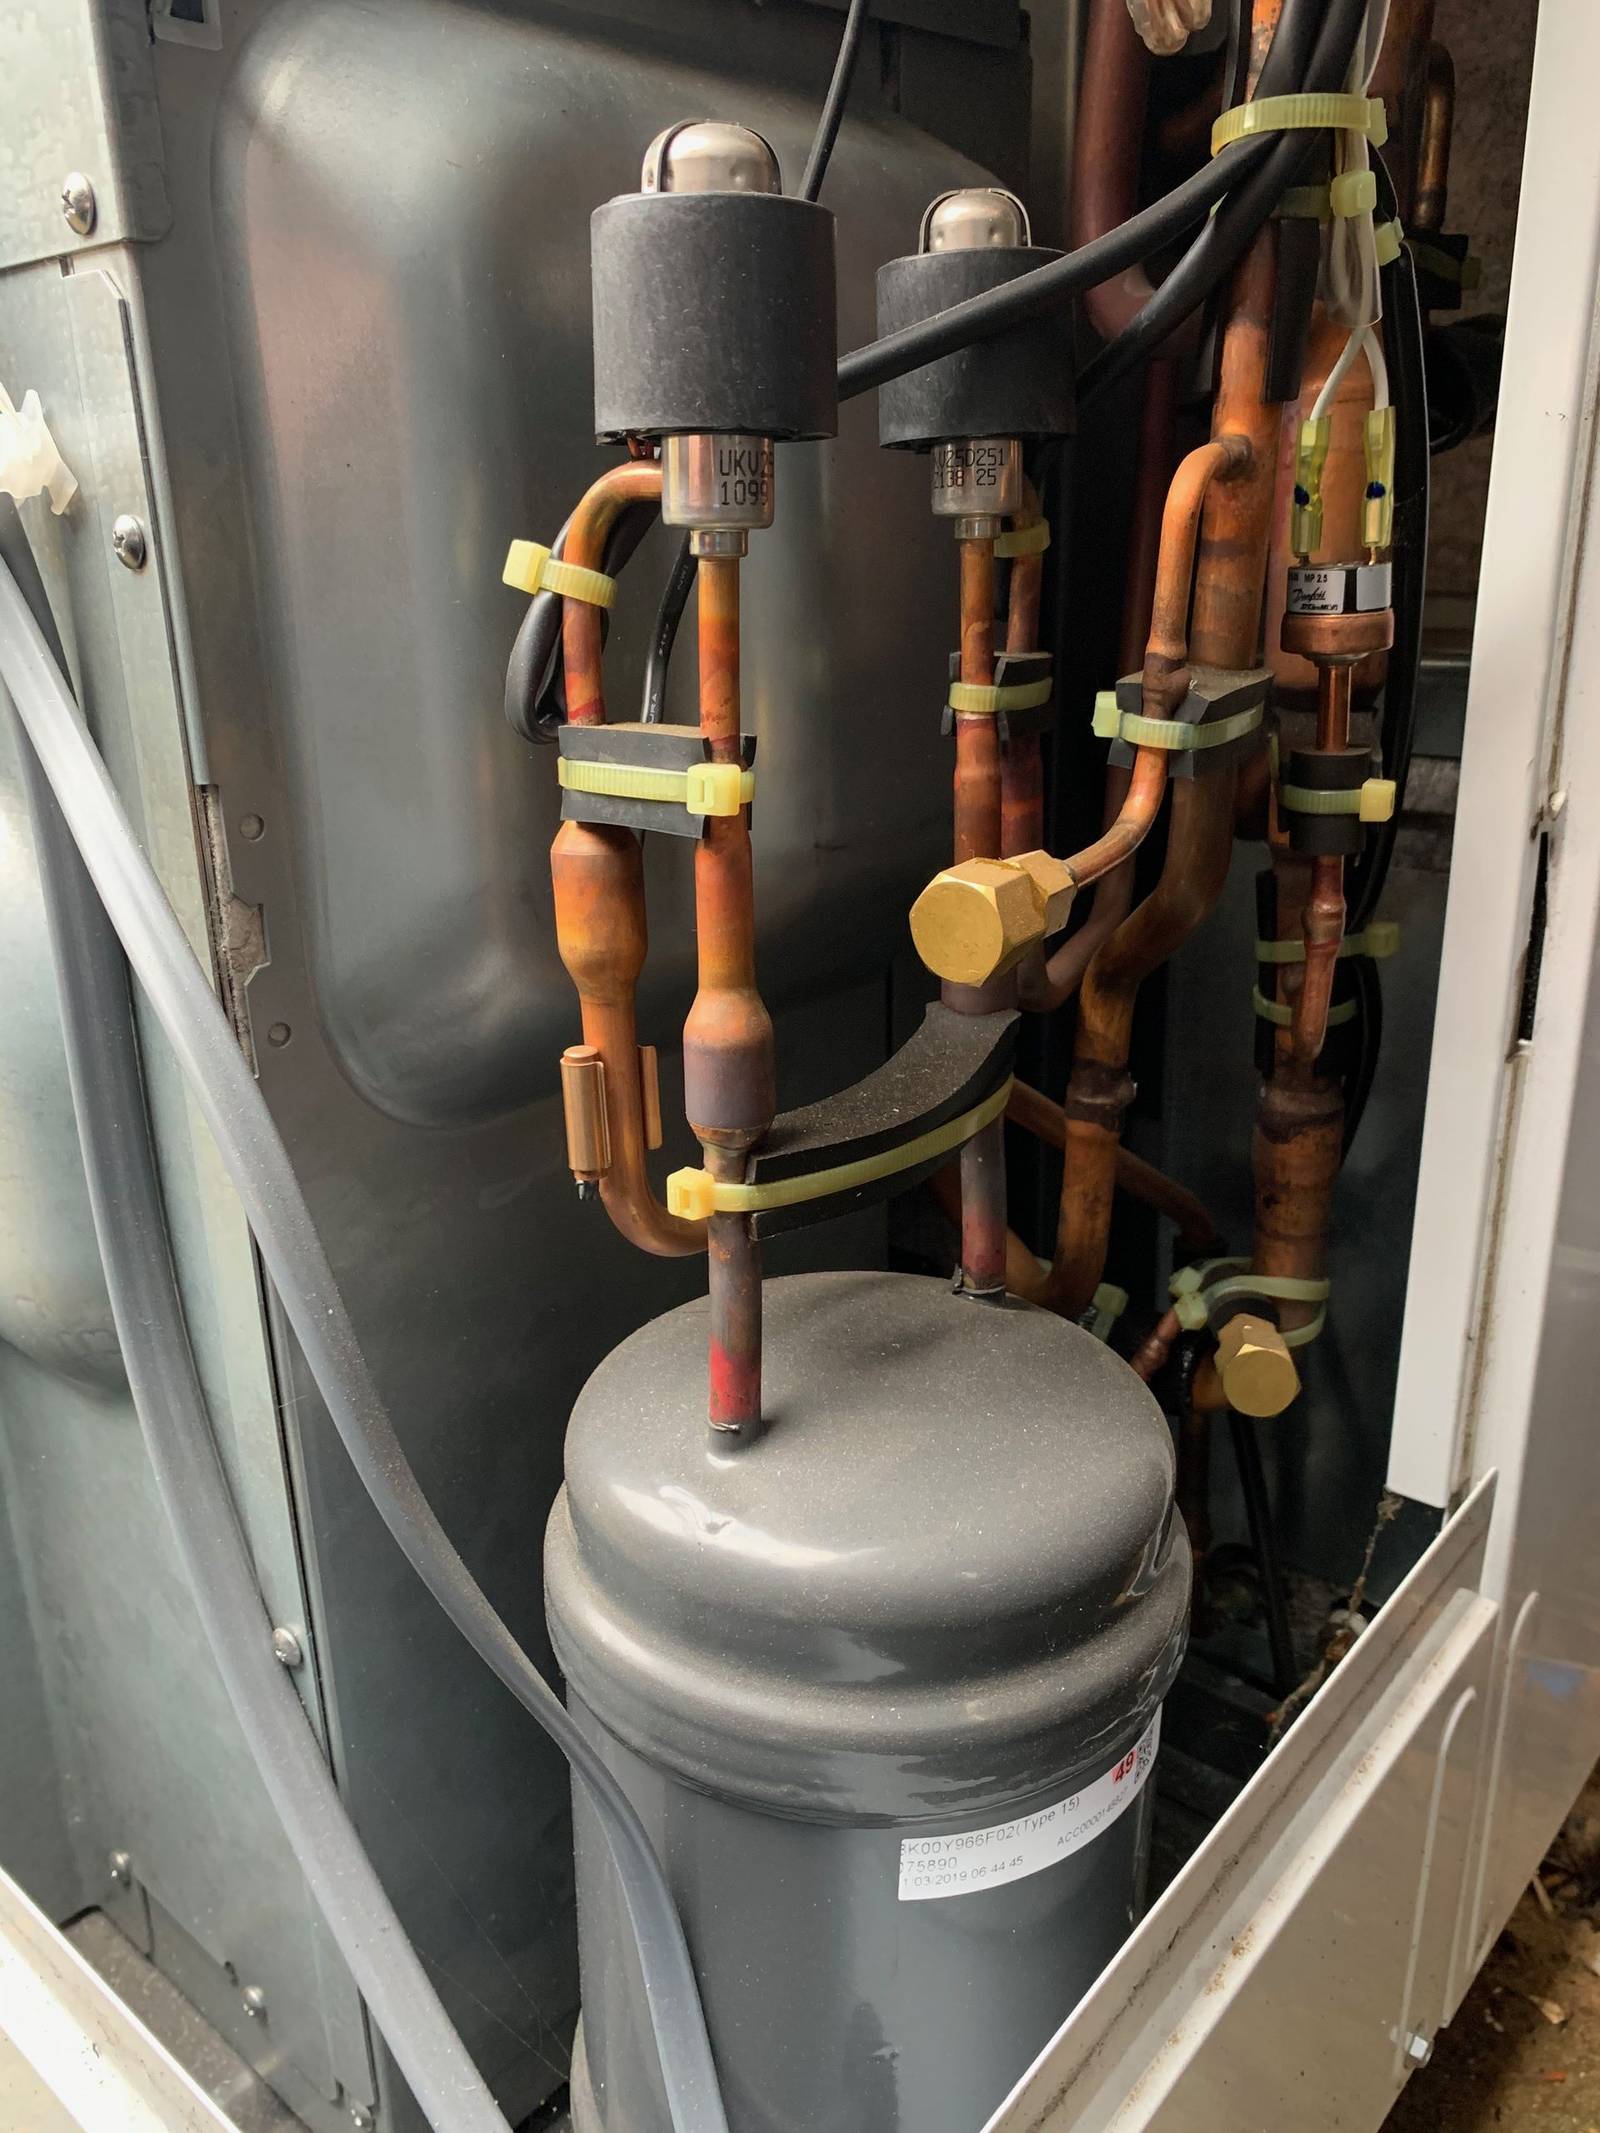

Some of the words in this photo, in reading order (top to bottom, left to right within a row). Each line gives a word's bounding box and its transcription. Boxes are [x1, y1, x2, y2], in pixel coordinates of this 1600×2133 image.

[976, 468, 997, 486] 25
[1114, 1750, 1135, 1783] 49
[900, 1810, 1056, 1856] K00Y966F02(Type
[1061, 1795, 1081, 1816] 15)
